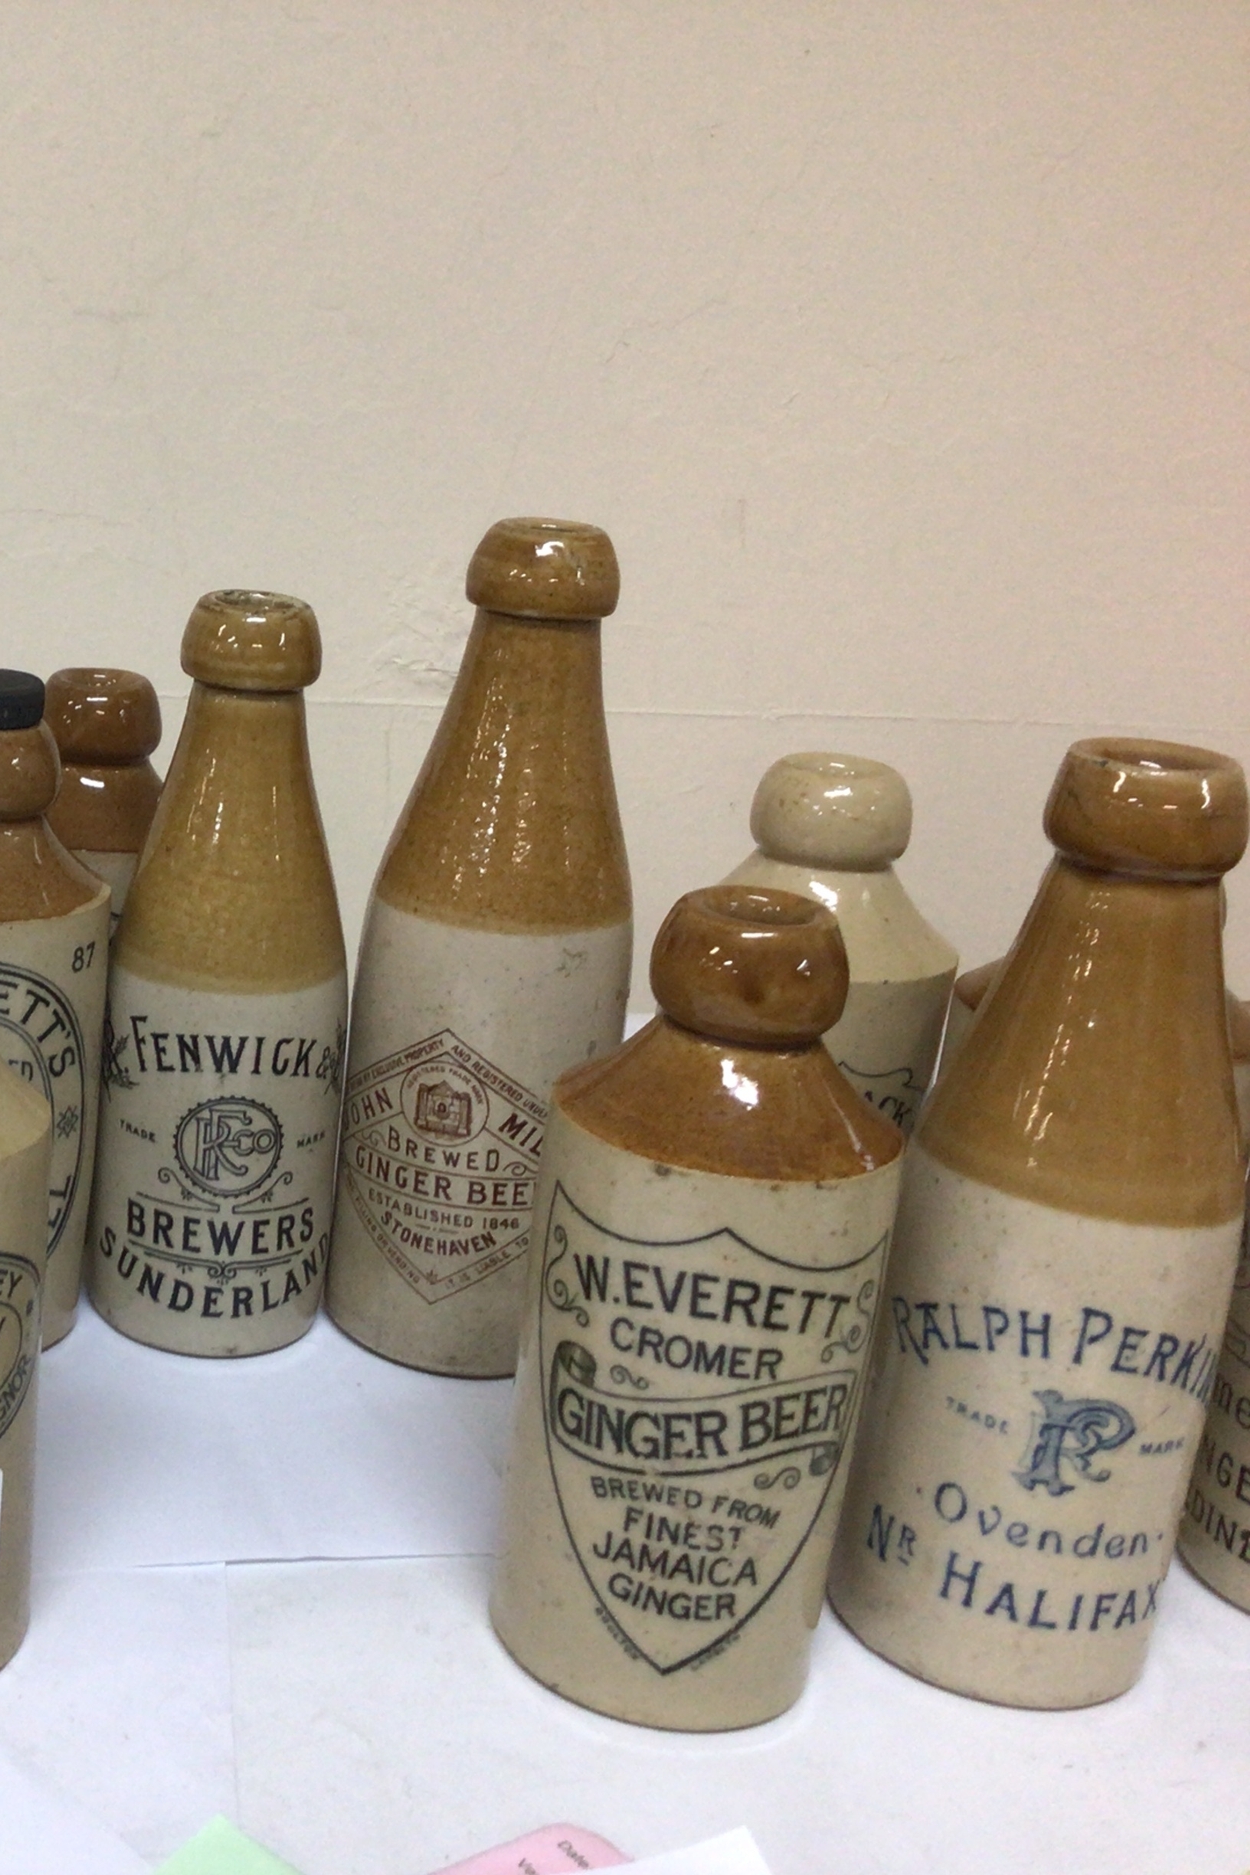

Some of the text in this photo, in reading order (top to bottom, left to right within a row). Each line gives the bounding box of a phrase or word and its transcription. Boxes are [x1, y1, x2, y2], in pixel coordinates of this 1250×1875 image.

[72, 941, 95, 973] 87
[130, 1015, 317, 1077] FENWICK
[404, 1039, 445, 1064] PROPERTY
[451, 1044, 471, 1063] AND
[472, 1059, 524, 1103] REGISTERED
[120, 1119, 326, 1150] TRADE MARK
[387, 1124, 500, 1173] BREWED
[355, 1145, 453, 1201] GINGER
[127, 1198, 314, 1257] BREWERS
[368, 1188, 473, 1228] ESTABLISHED
[380, 1211, 497, 1257] STONEHAVEN
[98, 1225, 330, 1319] SUNDERLAND
[610, 1315, 784, 1381] CROMER
[891, 1296, 1050, 1366] RALPH
[557, 1383, 848, 1461] GINGER BEER
[946, 1395, 1186, 1456] TRADE MARK
[590, 1475, 781, 1530] BREWED FROM
[623, 1506, 746, 1552] FINEST
[593, 1531, 759, 1587] JAMAICA
[607, 1572, 737, 1621] GINGER
